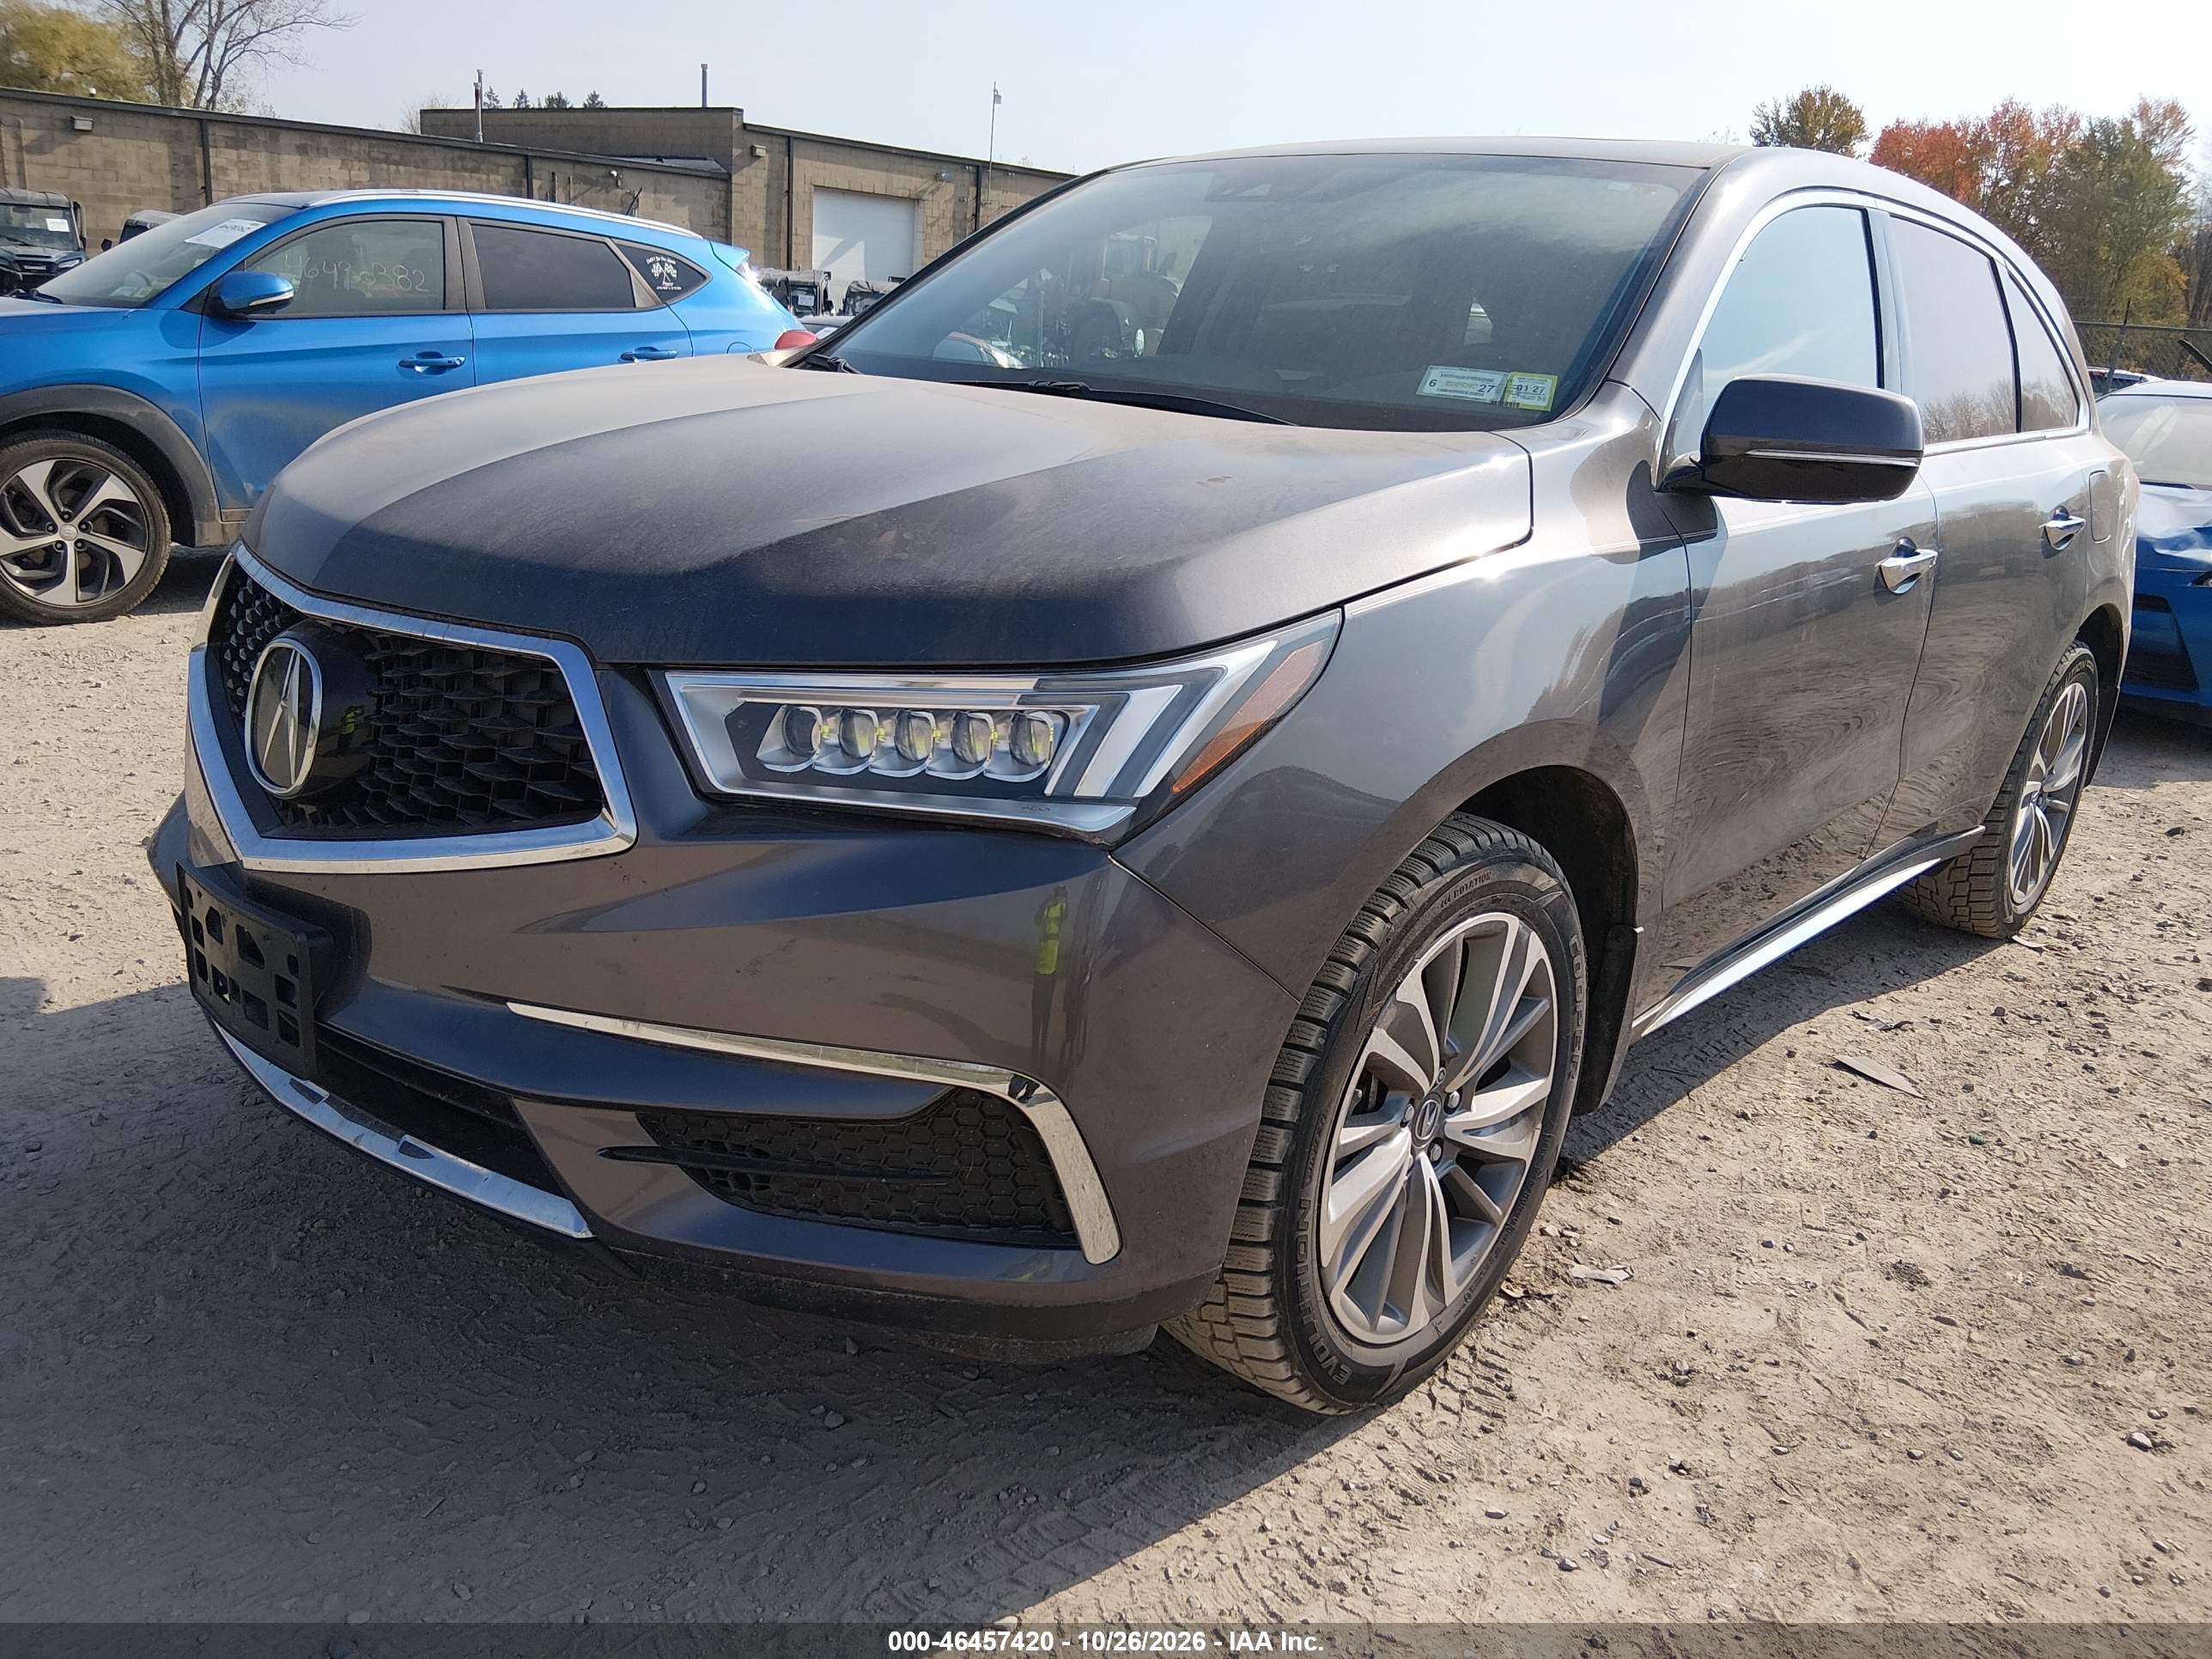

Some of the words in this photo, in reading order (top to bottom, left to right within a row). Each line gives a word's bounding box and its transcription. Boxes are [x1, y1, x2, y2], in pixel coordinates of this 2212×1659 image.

[1428, 379, 1438, 387] 6
[1478, 384, 1496, 393] 27
[1532, 386, 1546, 396] 27
[1569, 934, 1586, 1080] COOPER
[1296, 1198, 1353, 1387] EVOLUTION
